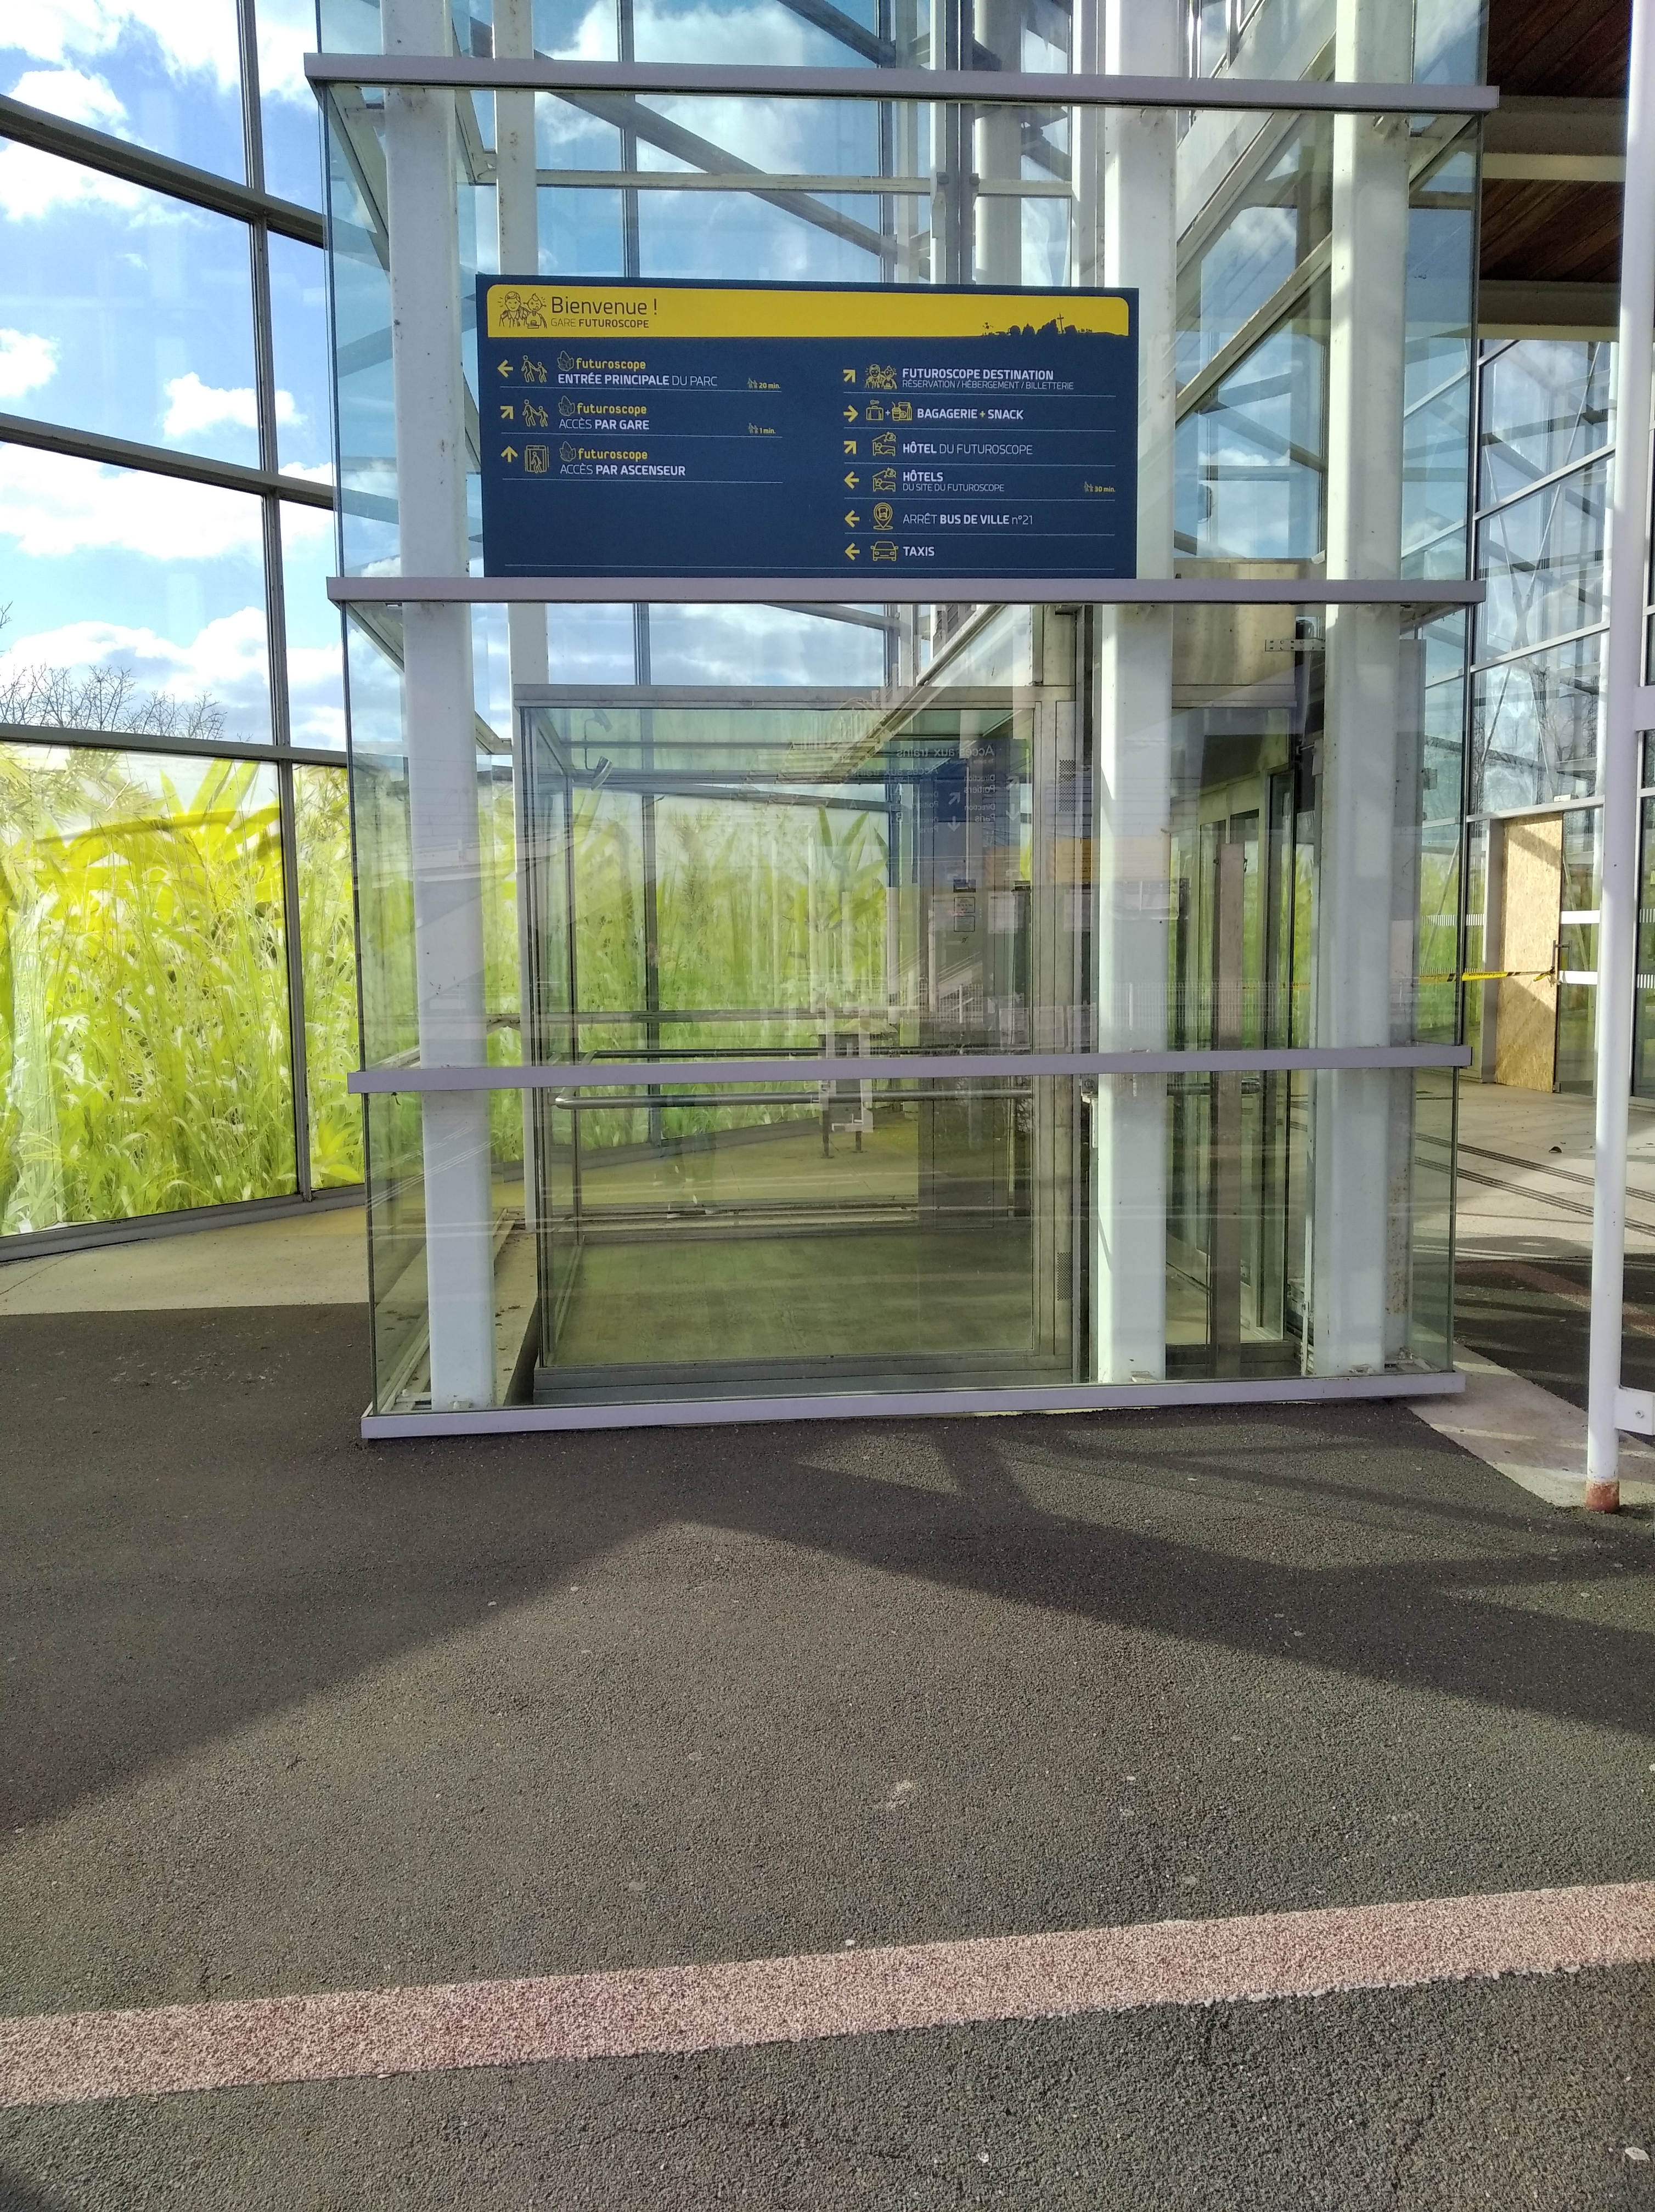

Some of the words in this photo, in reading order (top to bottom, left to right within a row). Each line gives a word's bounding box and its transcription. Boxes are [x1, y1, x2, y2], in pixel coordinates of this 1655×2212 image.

[551, 296, 647, 315] Bienvenue
[654, 298, 657, 315] !
[550, 318, 577, 327] GARE
[578, 319, 649, 328] FUTUROSCOPE
[576, 357, 646, 371] futuroscope
[558, 372, 602, 385] ENTRÉE
[604, 374, 670, 385] PRINCIPALE
[672, 375, 688, 386] DU
[690, 376, 718, 386] PARC
[902, 368, 981, 379] FUTUROSCOPE
[982, 369, 1054, 380] DESTINATION
[902, 379, 956, 388] RÉSERVATION
[961, 379, 1020, 389] HÉBERGEMENT
[1026, 381, 1074, 390] BILLETTERIE
[577, 402, 647, 416] futuroscope
[917, 408, 978, 419] BAGAGERIE
[988, 409, 1024, 420] SNACK
[559, 417, 592, 429] ACCÈS
[594, 419, 617, 430] PAR
[619, 420, 650, 430] GARE
[903, 441, 937, 454] HÔTEL
[939, 443, 954, 454] DU
[956, 444, 1033, 455] FUTUROSCOPE
[578, 448, 648, 462] futuroscope
[560, 462, 593, 475] ACCÈS
[595, 465, 618, 475] PAR
[620, 465, 685, 476] ASCENSEUR
[903, 469, 943, 482] HÔTELS
[903, 483, 915, 491] DU
[915, 483, 933, 492] SITE
[934, 483, 946, 492] DU
[947, 483, 1005, 492] FUTUROSCOPE
[903, 512, 938, 524] ARRÊT
[940, 514, 961, 524] BUS
[964, 514, 978, 524] DE
[980, 514, 1010, 524] VILLE
[903, 546, 935, 556] TAXIS
